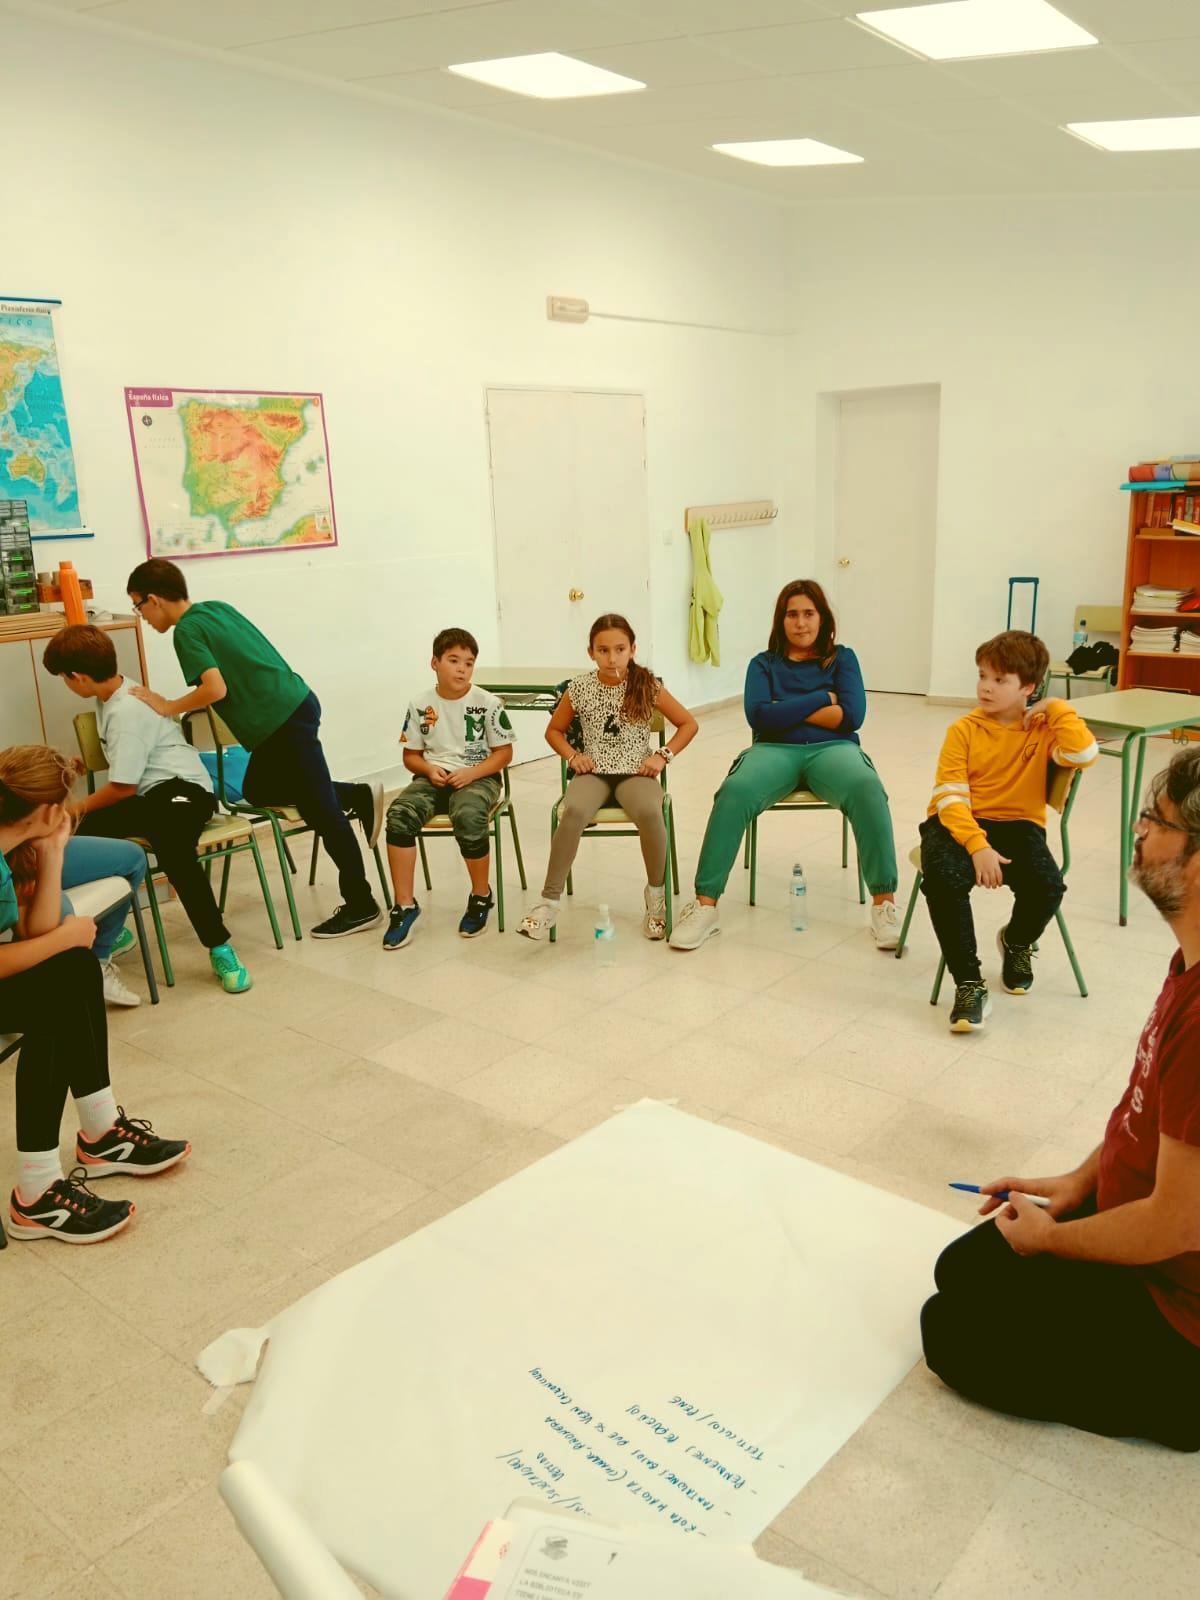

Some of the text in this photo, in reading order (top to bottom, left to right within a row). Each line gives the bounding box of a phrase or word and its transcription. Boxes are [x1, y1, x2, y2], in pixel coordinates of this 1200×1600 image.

[570, 1406, 593, 1425] VEAN
[594, 1422, 606, 1433] SE
[608, 1431, 631, 1447] QUE
[631, 1449, 659, 1471] BAJOS
[685, 1446, 746, 1489] PENDIENTES
[658, 1469, 714, 1511] PANTALONES
[670, 1512, 697, 1533] ROPA
